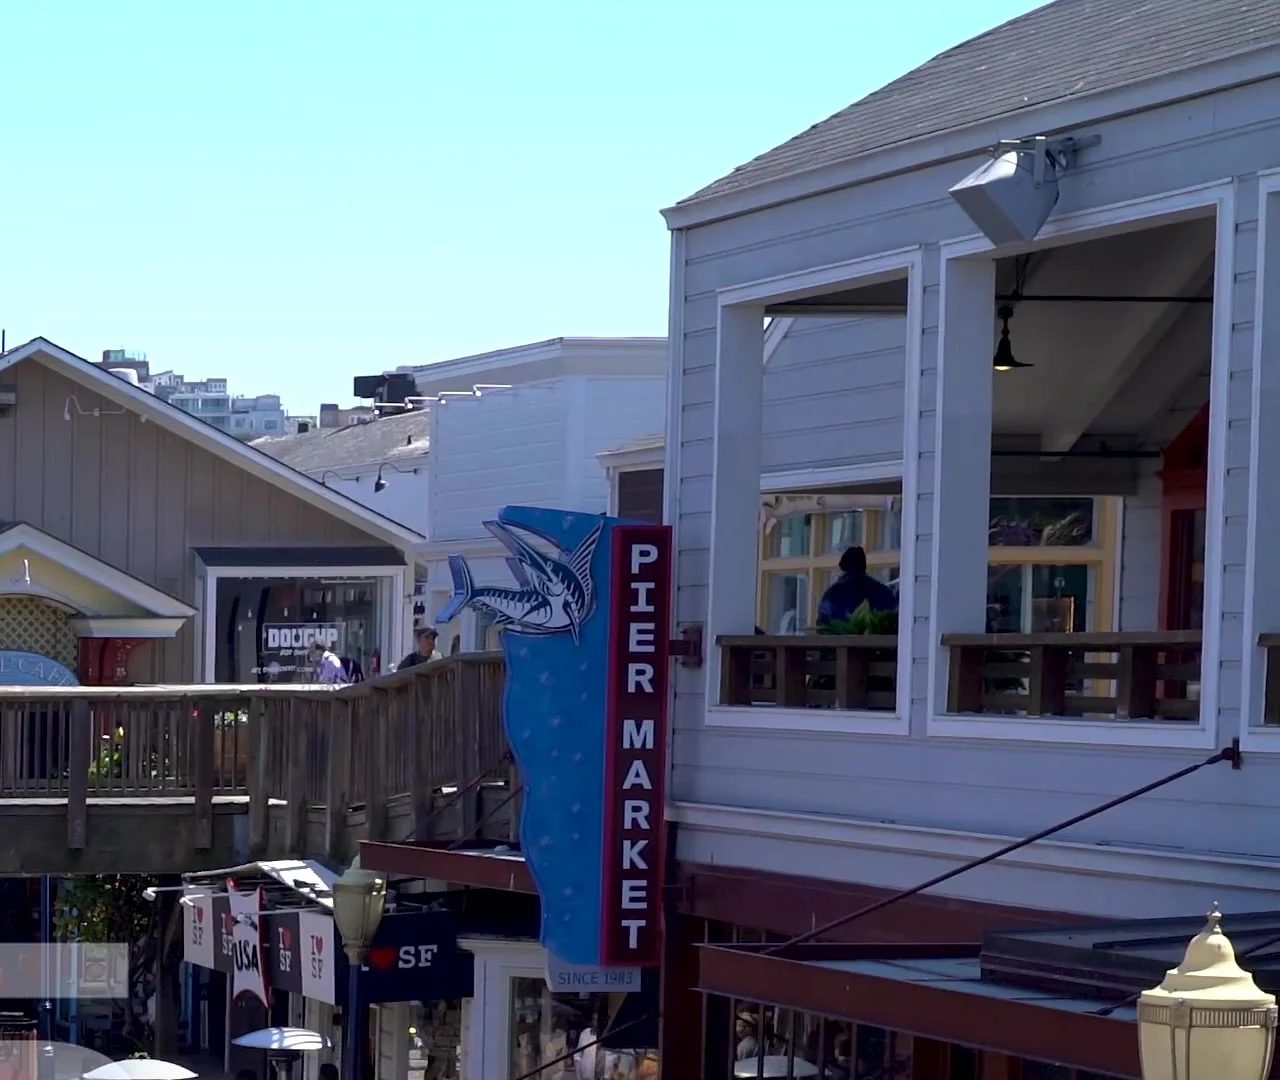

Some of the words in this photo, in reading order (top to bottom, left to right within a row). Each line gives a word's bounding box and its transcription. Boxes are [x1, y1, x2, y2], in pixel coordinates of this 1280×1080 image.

[628, 543, 658, 693] PIER
[621, 719, 654, 949] MARKET
[192, 926, 204, 946] SF
[234, 939, 260, 976] USA
[279, 951, 291, 972] SF
[311, 957, 324, 980] SF
[398, 944, 438, 969] SF
[558, 972, 599, 985] SINCE
